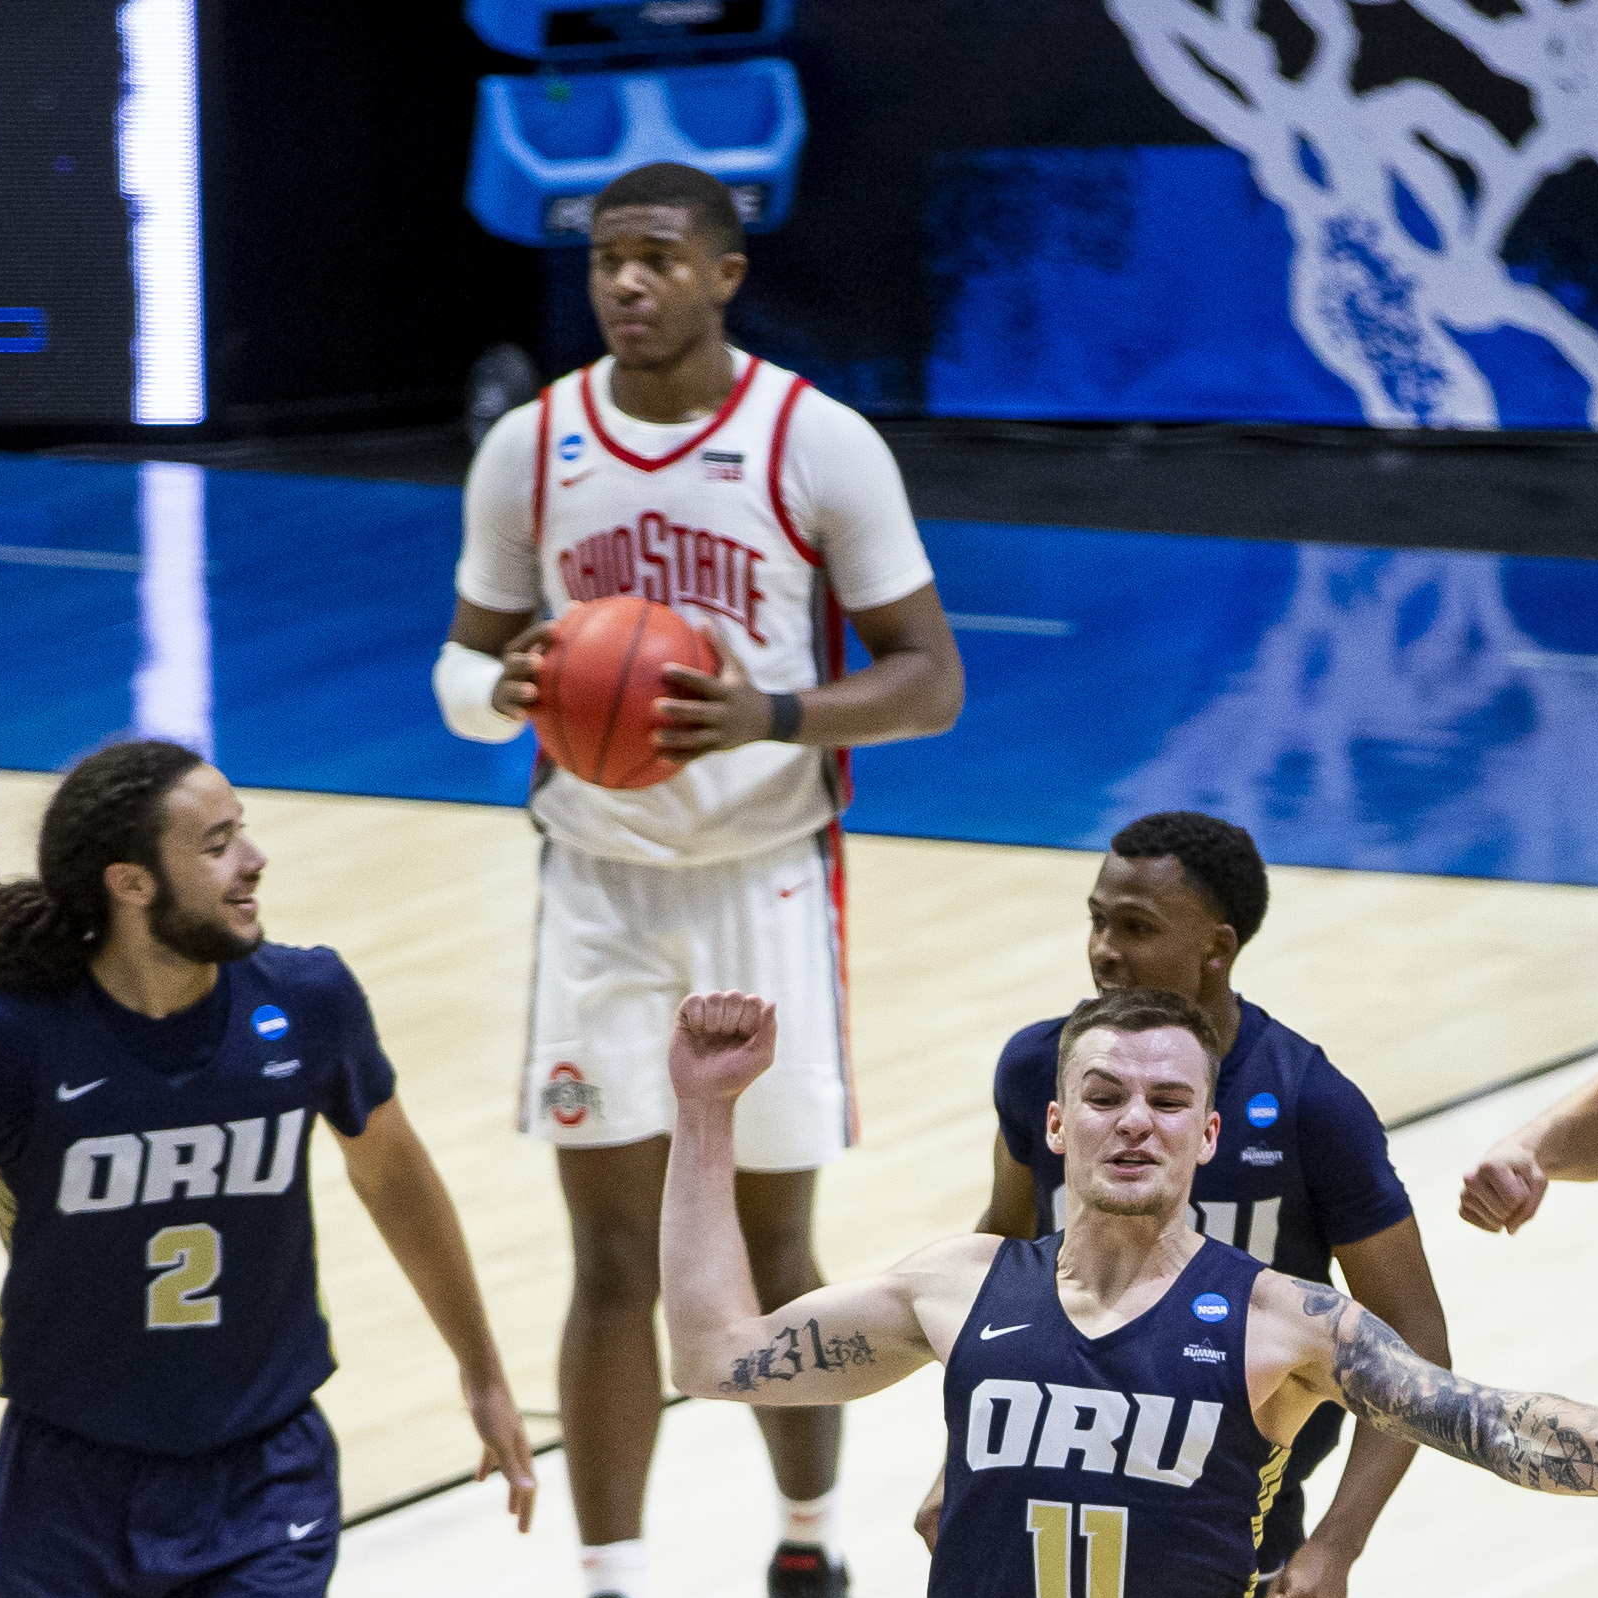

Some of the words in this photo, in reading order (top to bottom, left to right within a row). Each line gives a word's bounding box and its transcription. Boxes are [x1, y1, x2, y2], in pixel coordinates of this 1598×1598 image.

[57, 1108, 306, 1216] ORU
[146, 1222, 222, 1331] 2
[967, 1378, 1223, 1489] ORU
